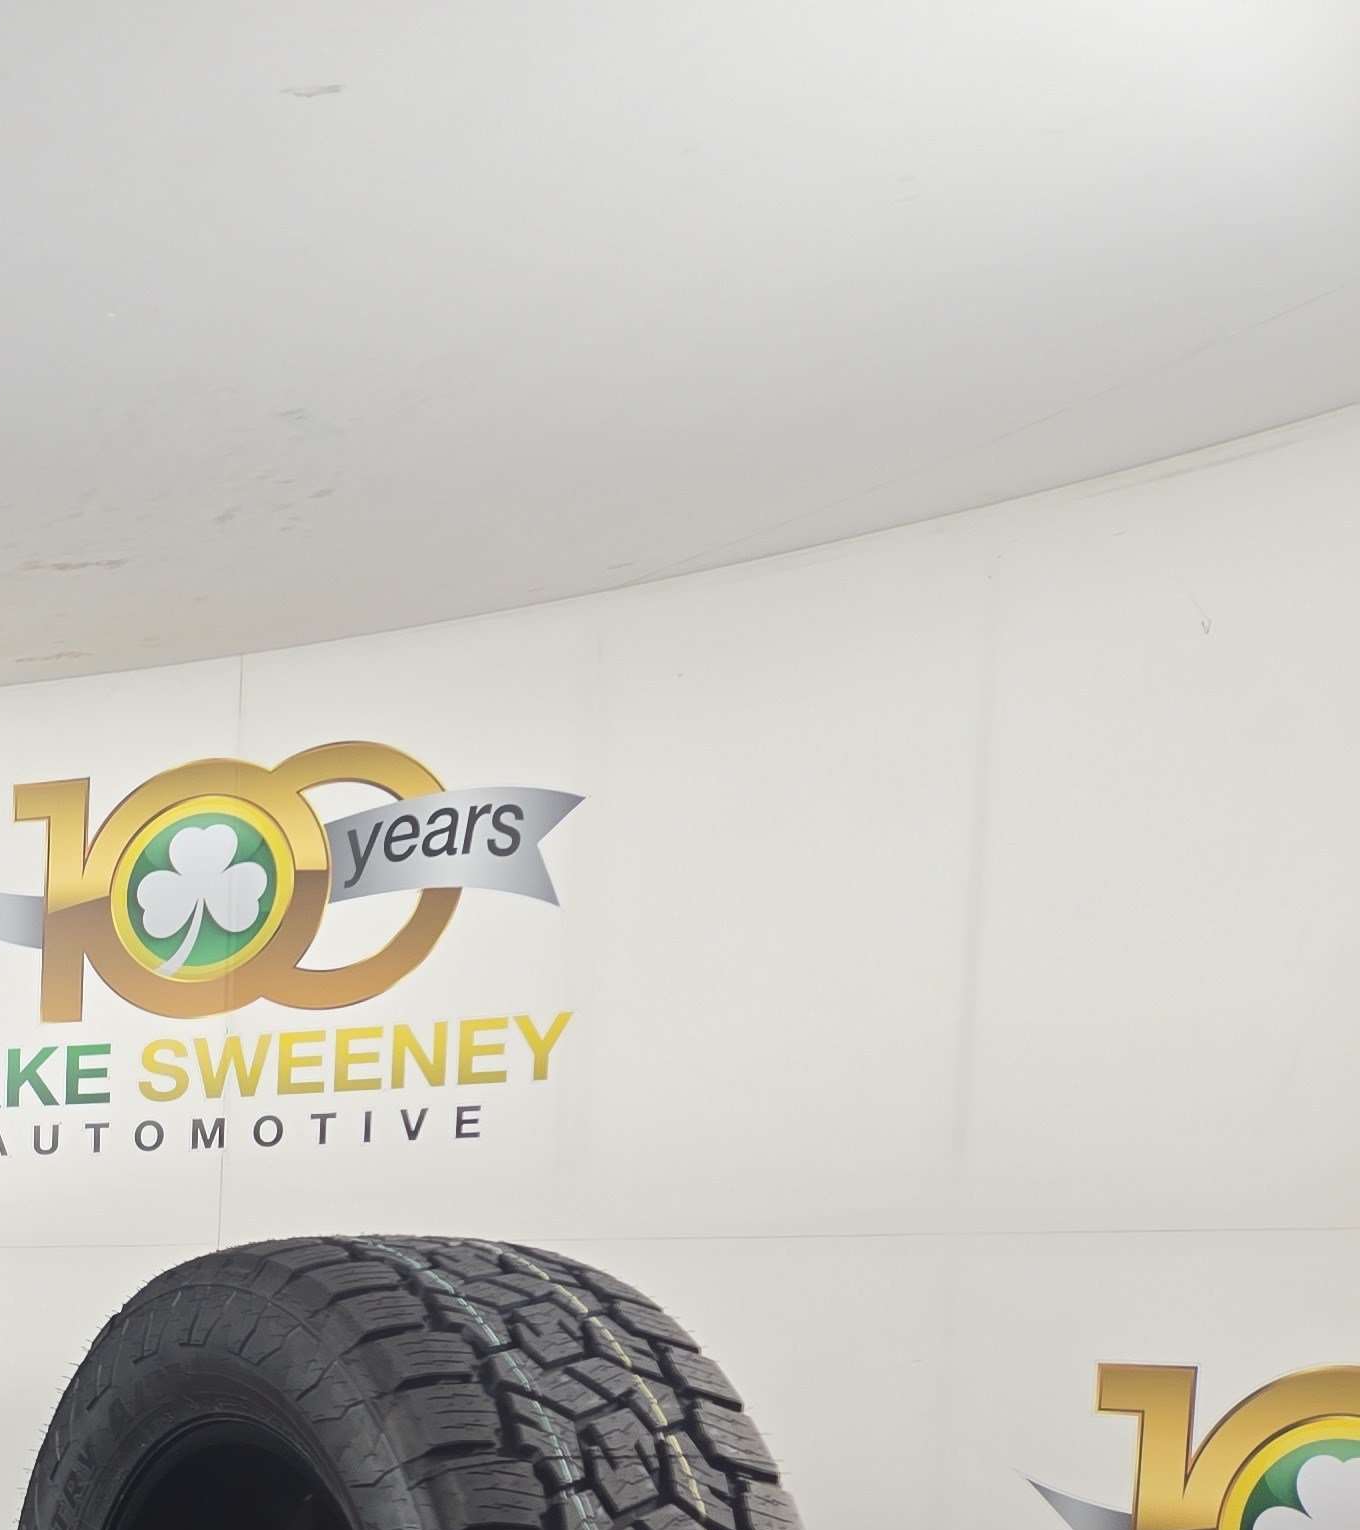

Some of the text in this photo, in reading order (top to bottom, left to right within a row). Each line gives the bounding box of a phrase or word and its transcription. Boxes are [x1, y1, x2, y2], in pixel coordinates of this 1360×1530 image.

[13, 740, 526, 1023] 100 years
[138, 1011, 573, 1102] SWEENEY
